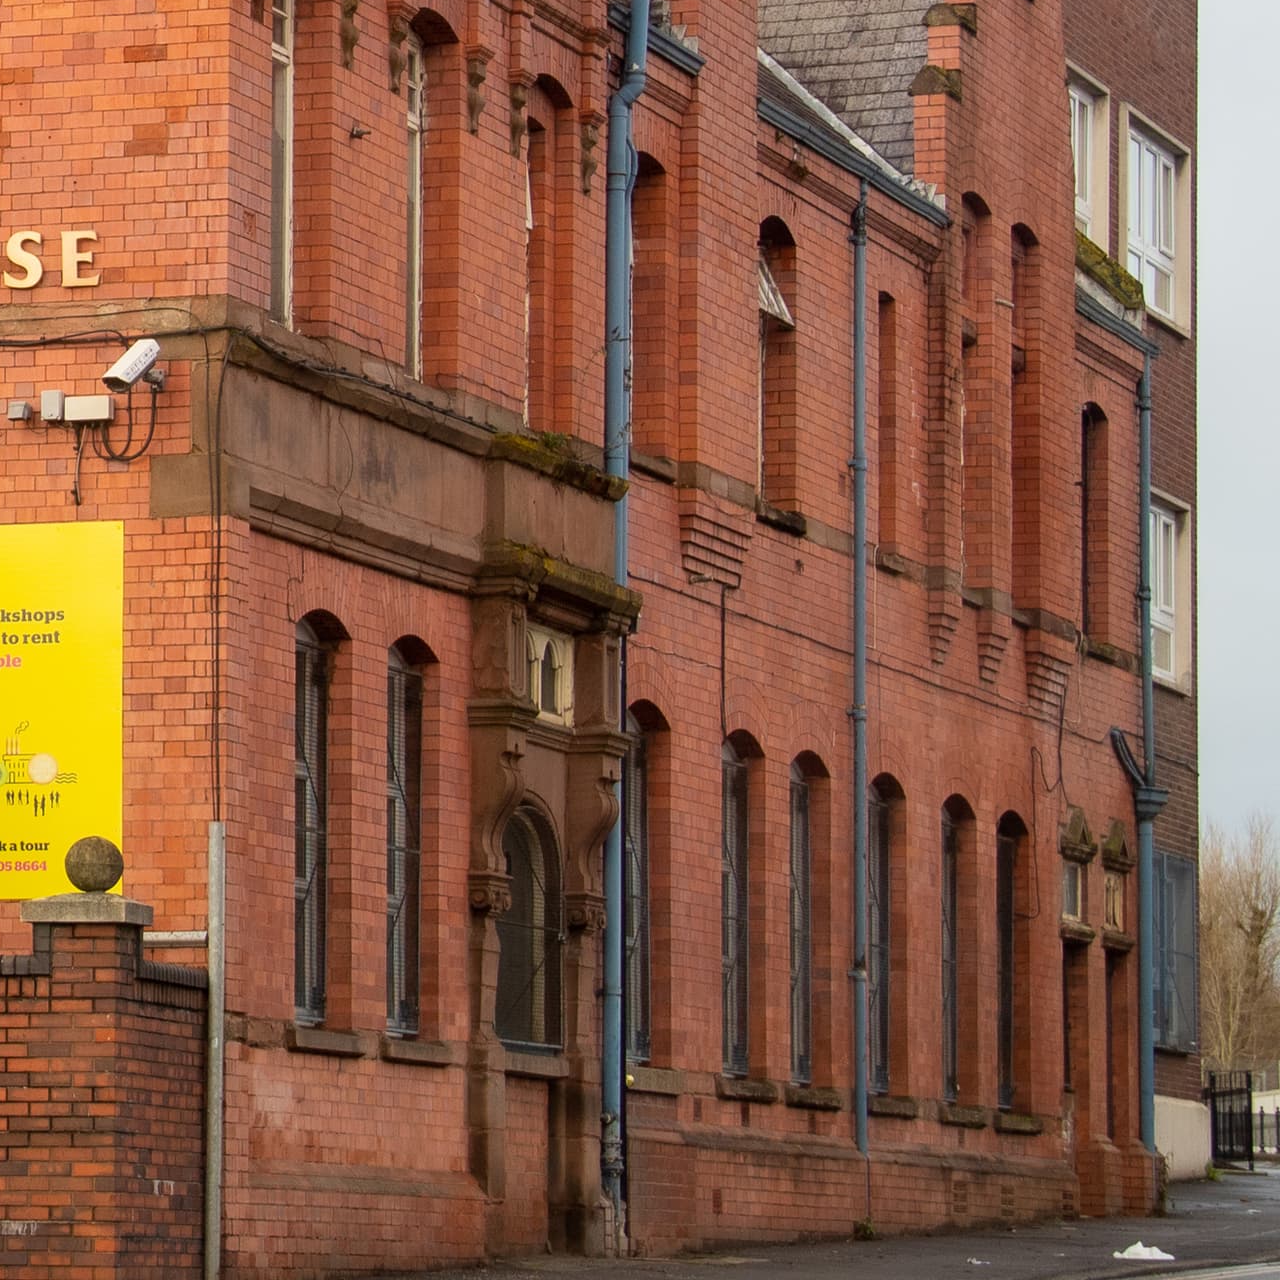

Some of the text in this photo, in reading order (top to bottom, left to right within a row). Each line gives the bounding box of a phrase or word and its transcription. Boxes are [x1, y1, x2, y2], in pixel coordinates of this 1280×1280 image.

[1, 632, 20, 645] to
[22, 631, 61, 644] rent
[10, 842, 17, 851] a
[20, 841, 50, 851] tour
